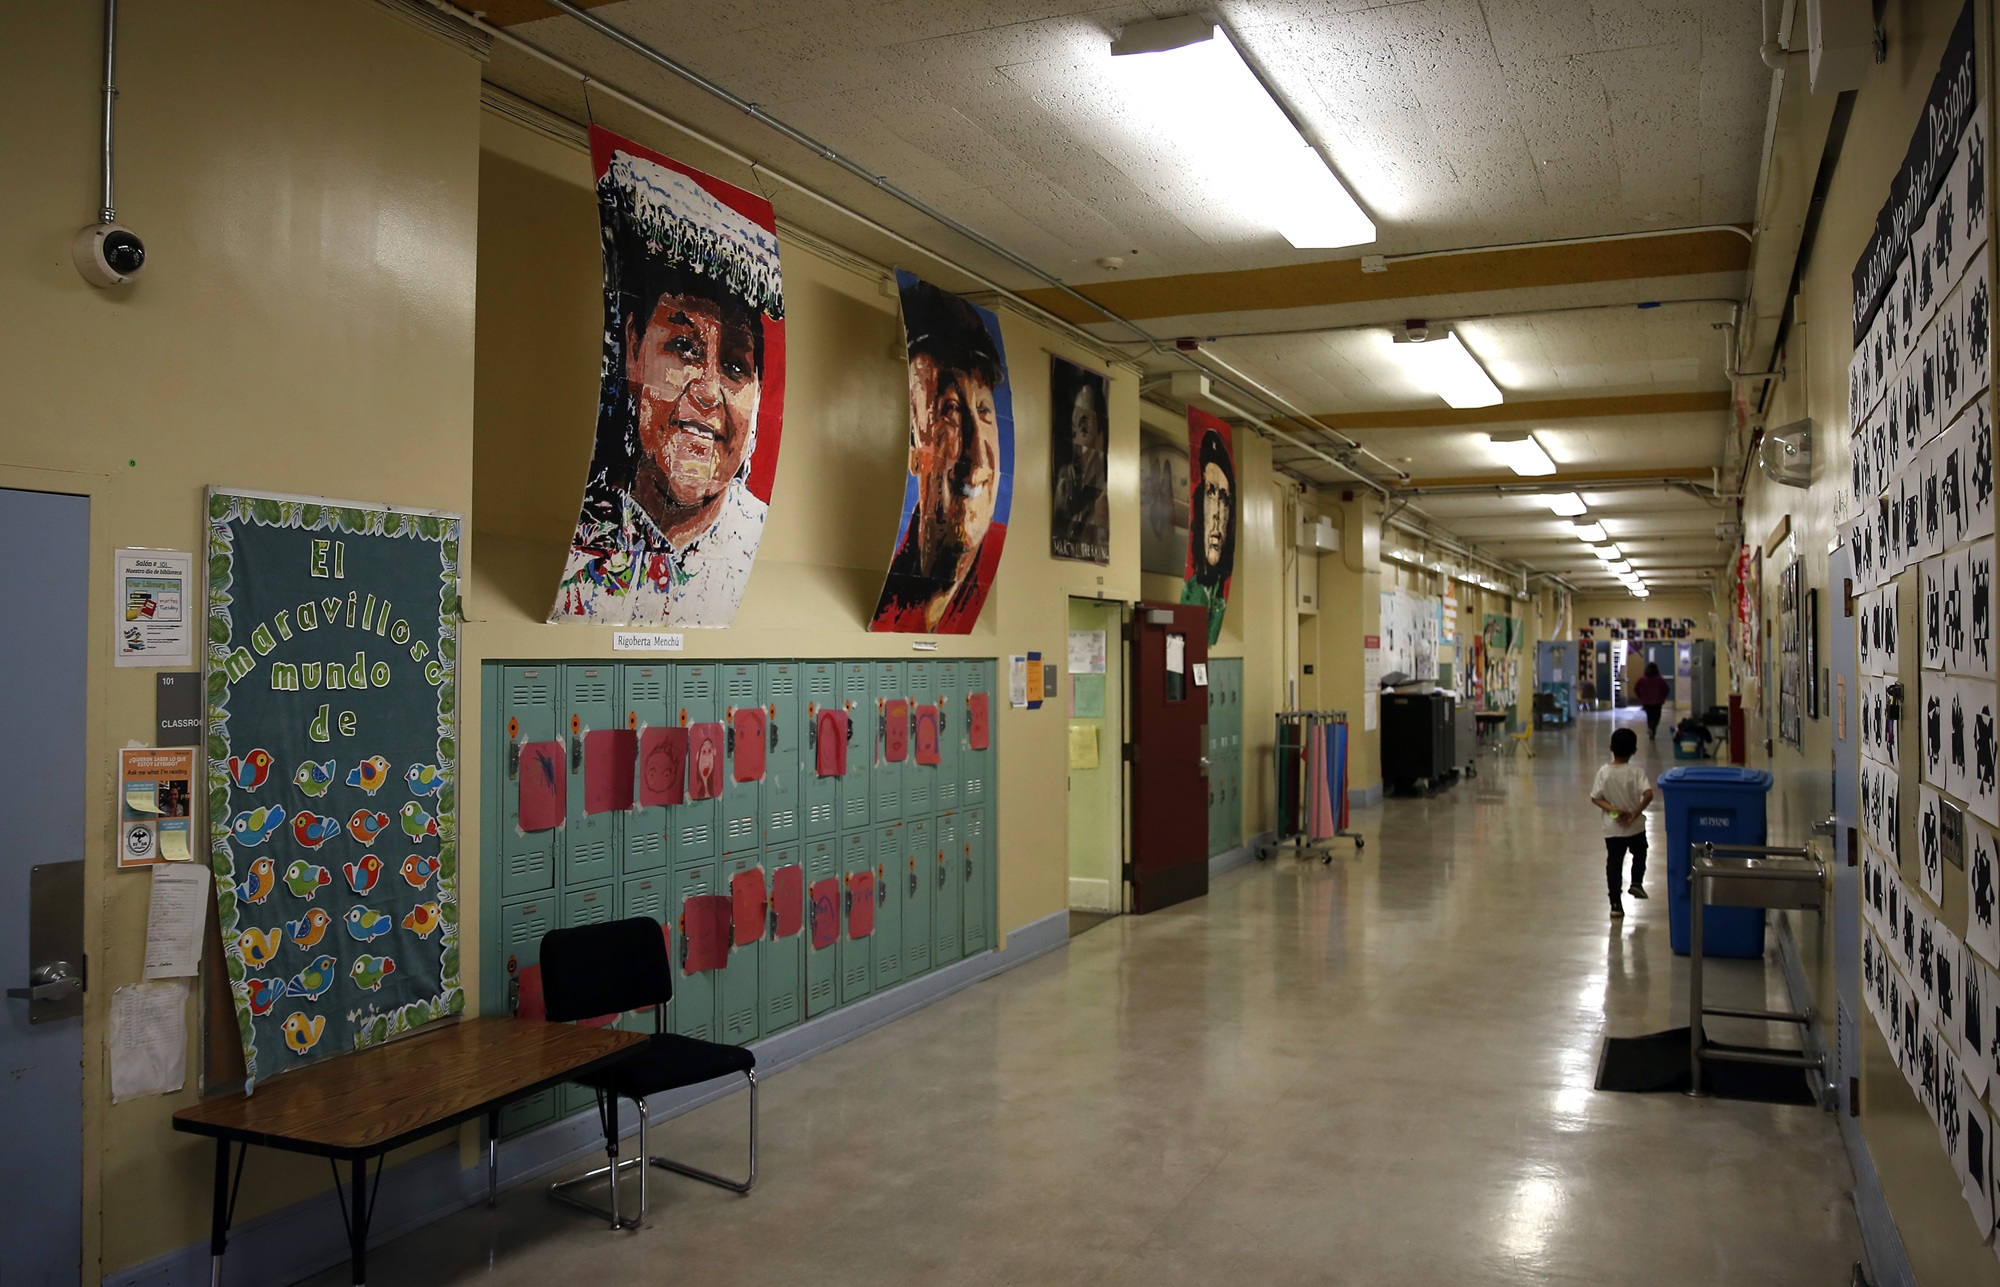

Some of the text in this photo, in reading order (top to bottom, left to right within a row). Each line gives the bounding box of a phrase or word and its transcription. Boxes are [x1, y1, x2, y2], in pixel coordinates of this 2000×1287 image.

[1892, 165, 1929, 256] Negative
[1929, 50, 1972, 182] Designs
[311, 539, 345, 579] El
[142, 581, 166, 590] Library
[167, 582, 180, 591] Day
[223, 591, 443, 686] maravilloso
[618, 635, 679, 648] Rigoberta Menchú
[162, 677, 174, 685] 101
[271, 651, 391, 691] mundo
[309, 704, 356, 743] de
